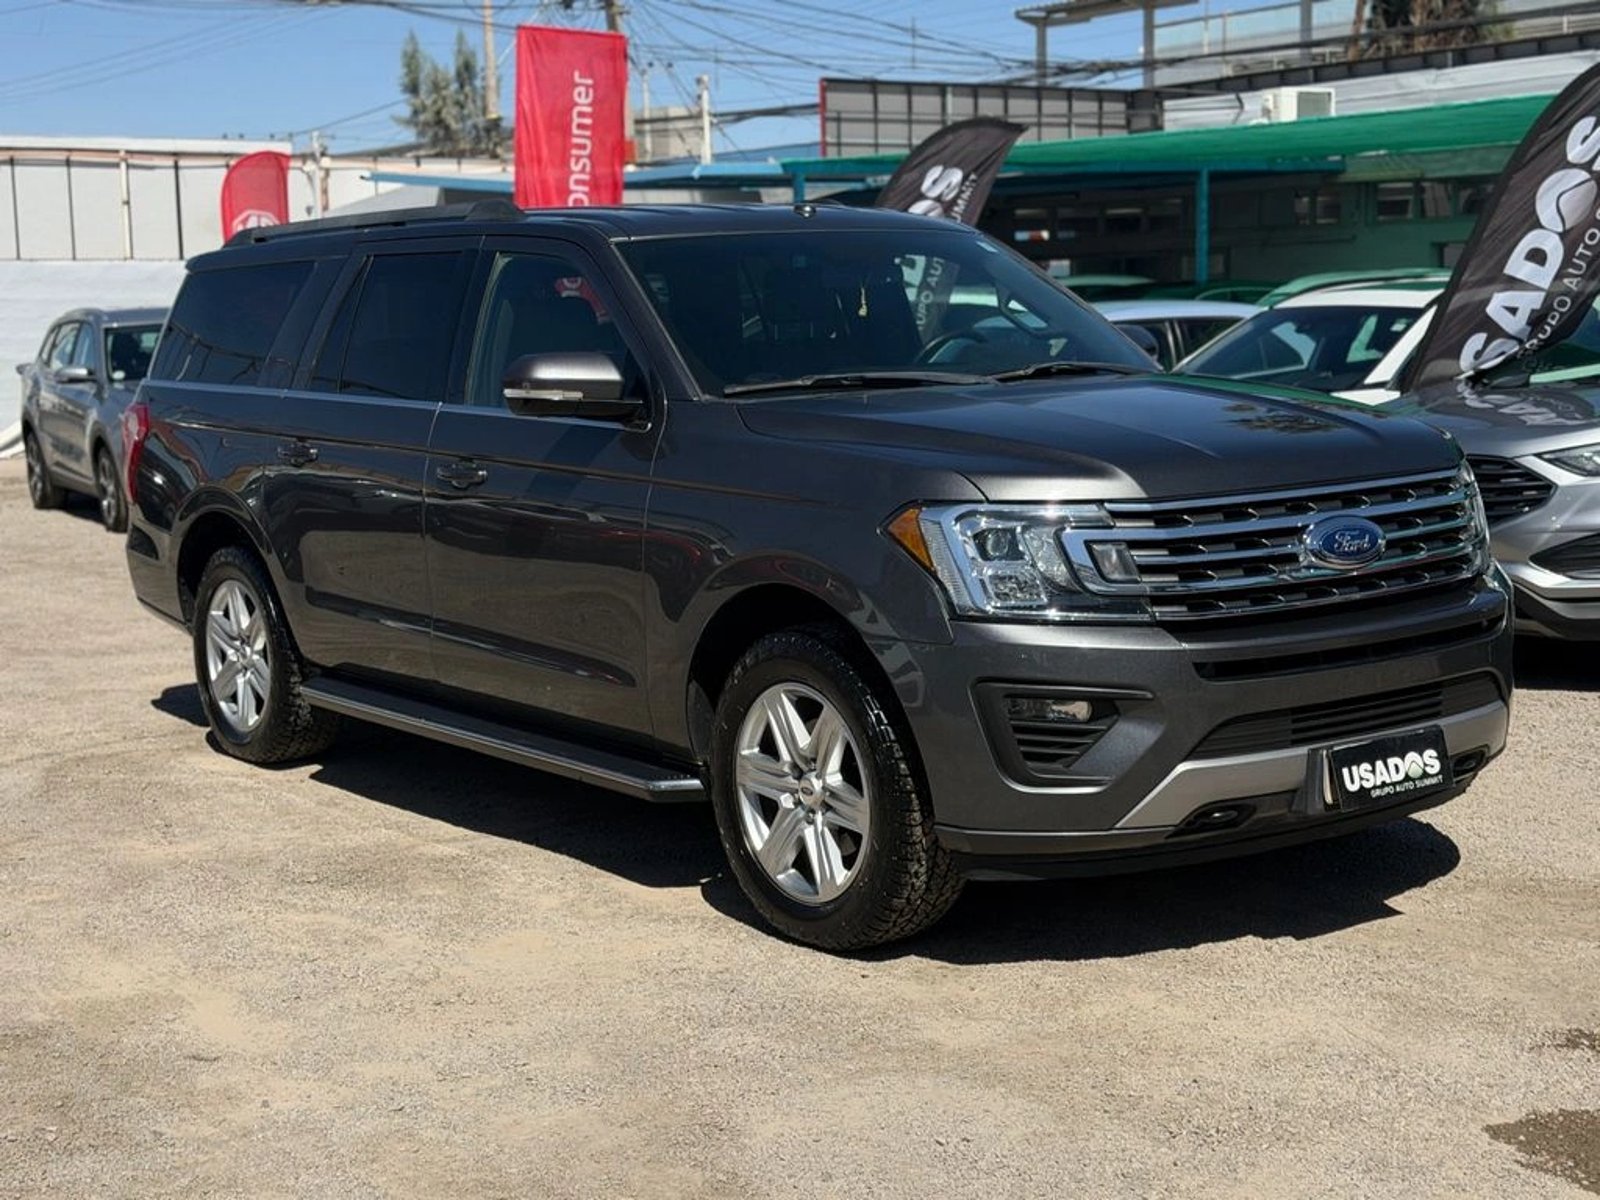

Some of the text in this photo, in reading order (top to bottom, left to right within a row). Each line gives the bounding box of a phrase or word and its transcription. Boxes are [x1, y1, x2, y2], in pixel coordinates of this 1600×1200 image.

[1562, 228, 1600, 291] AUTO
[1334, 530, 1372, 553] Ford
[1341, 748, 1442, 793] USADOS
[1370, 785, 1395, 798] GRUPO
[1395, 780, 1415, 793] AUTO
